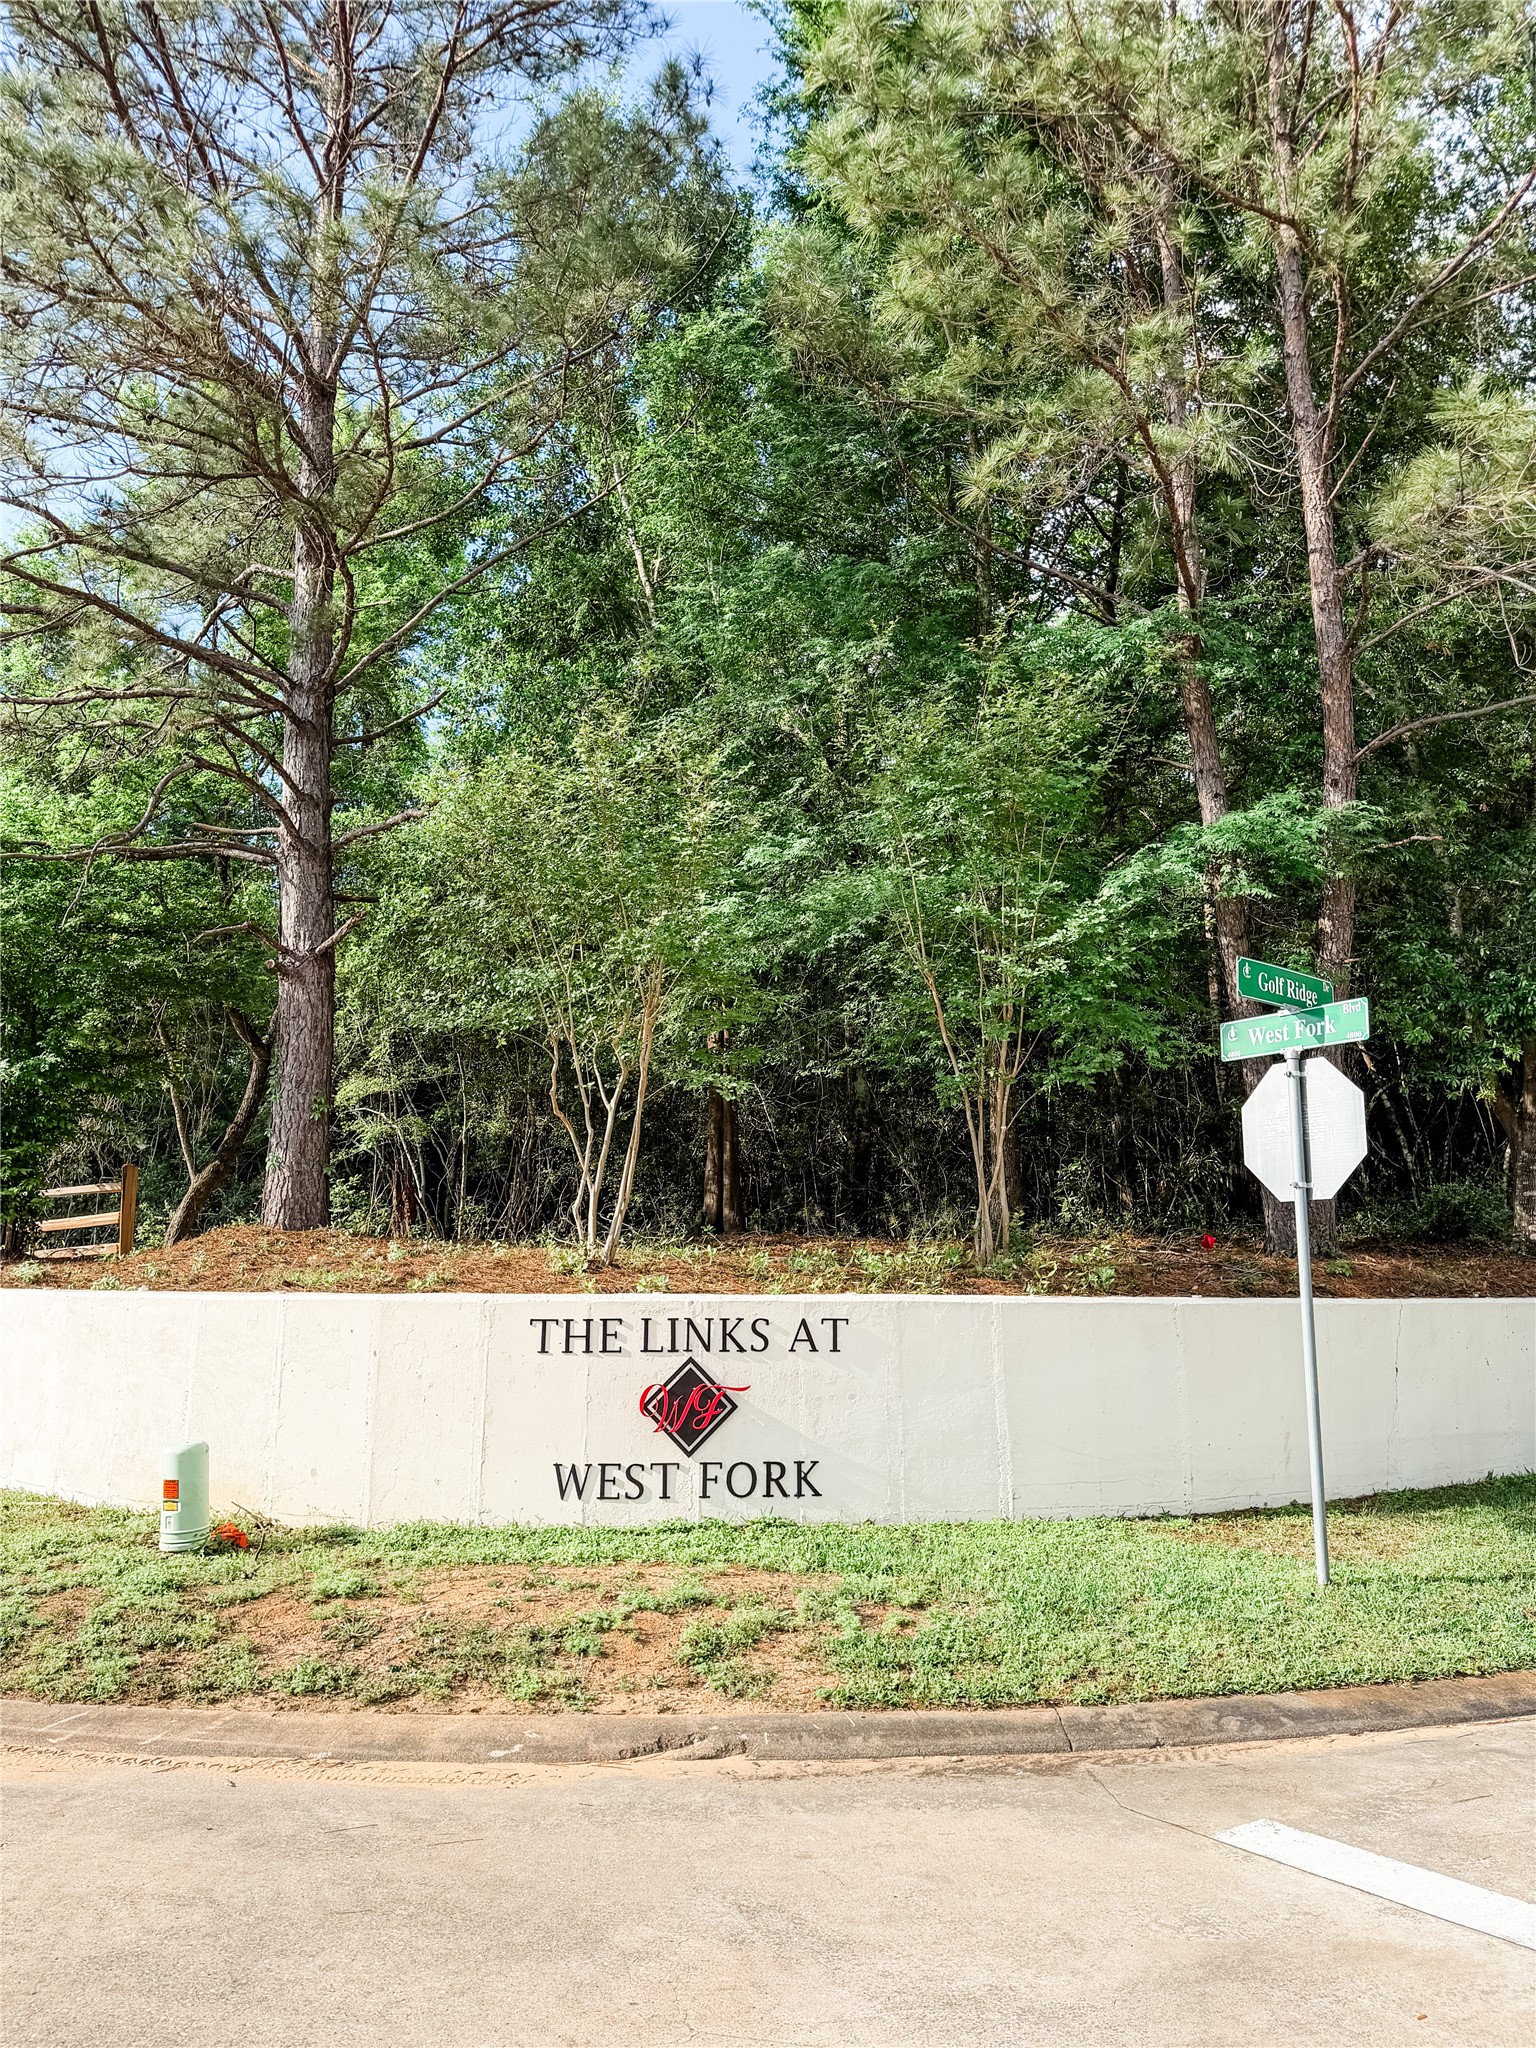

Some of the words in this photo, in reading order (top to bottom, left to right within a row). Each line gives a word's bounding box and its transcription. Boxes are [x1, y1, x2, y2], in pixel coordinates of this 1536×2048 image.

[1258, 972, 1284, 996] Golf
[1287, 979, 1318, 1007] Ridge
[1322, 982, 1330, 992] Dr
[1343, 1002, 1361, 1014] Blvd
[1248, 1025, 1289, 1047] West
[1294, 1015, 1337, 1040] Fork
[1345, 1030, 1362, 1040] 4800
[530, 1318, 623, 1354] THE
[640, 1317, 770, 1353] LINKS
[789, 1317, 849, 1353] AT
[553, 1462, 680, 1501] WEST
[699, 1460, 823, 1499] FORK
